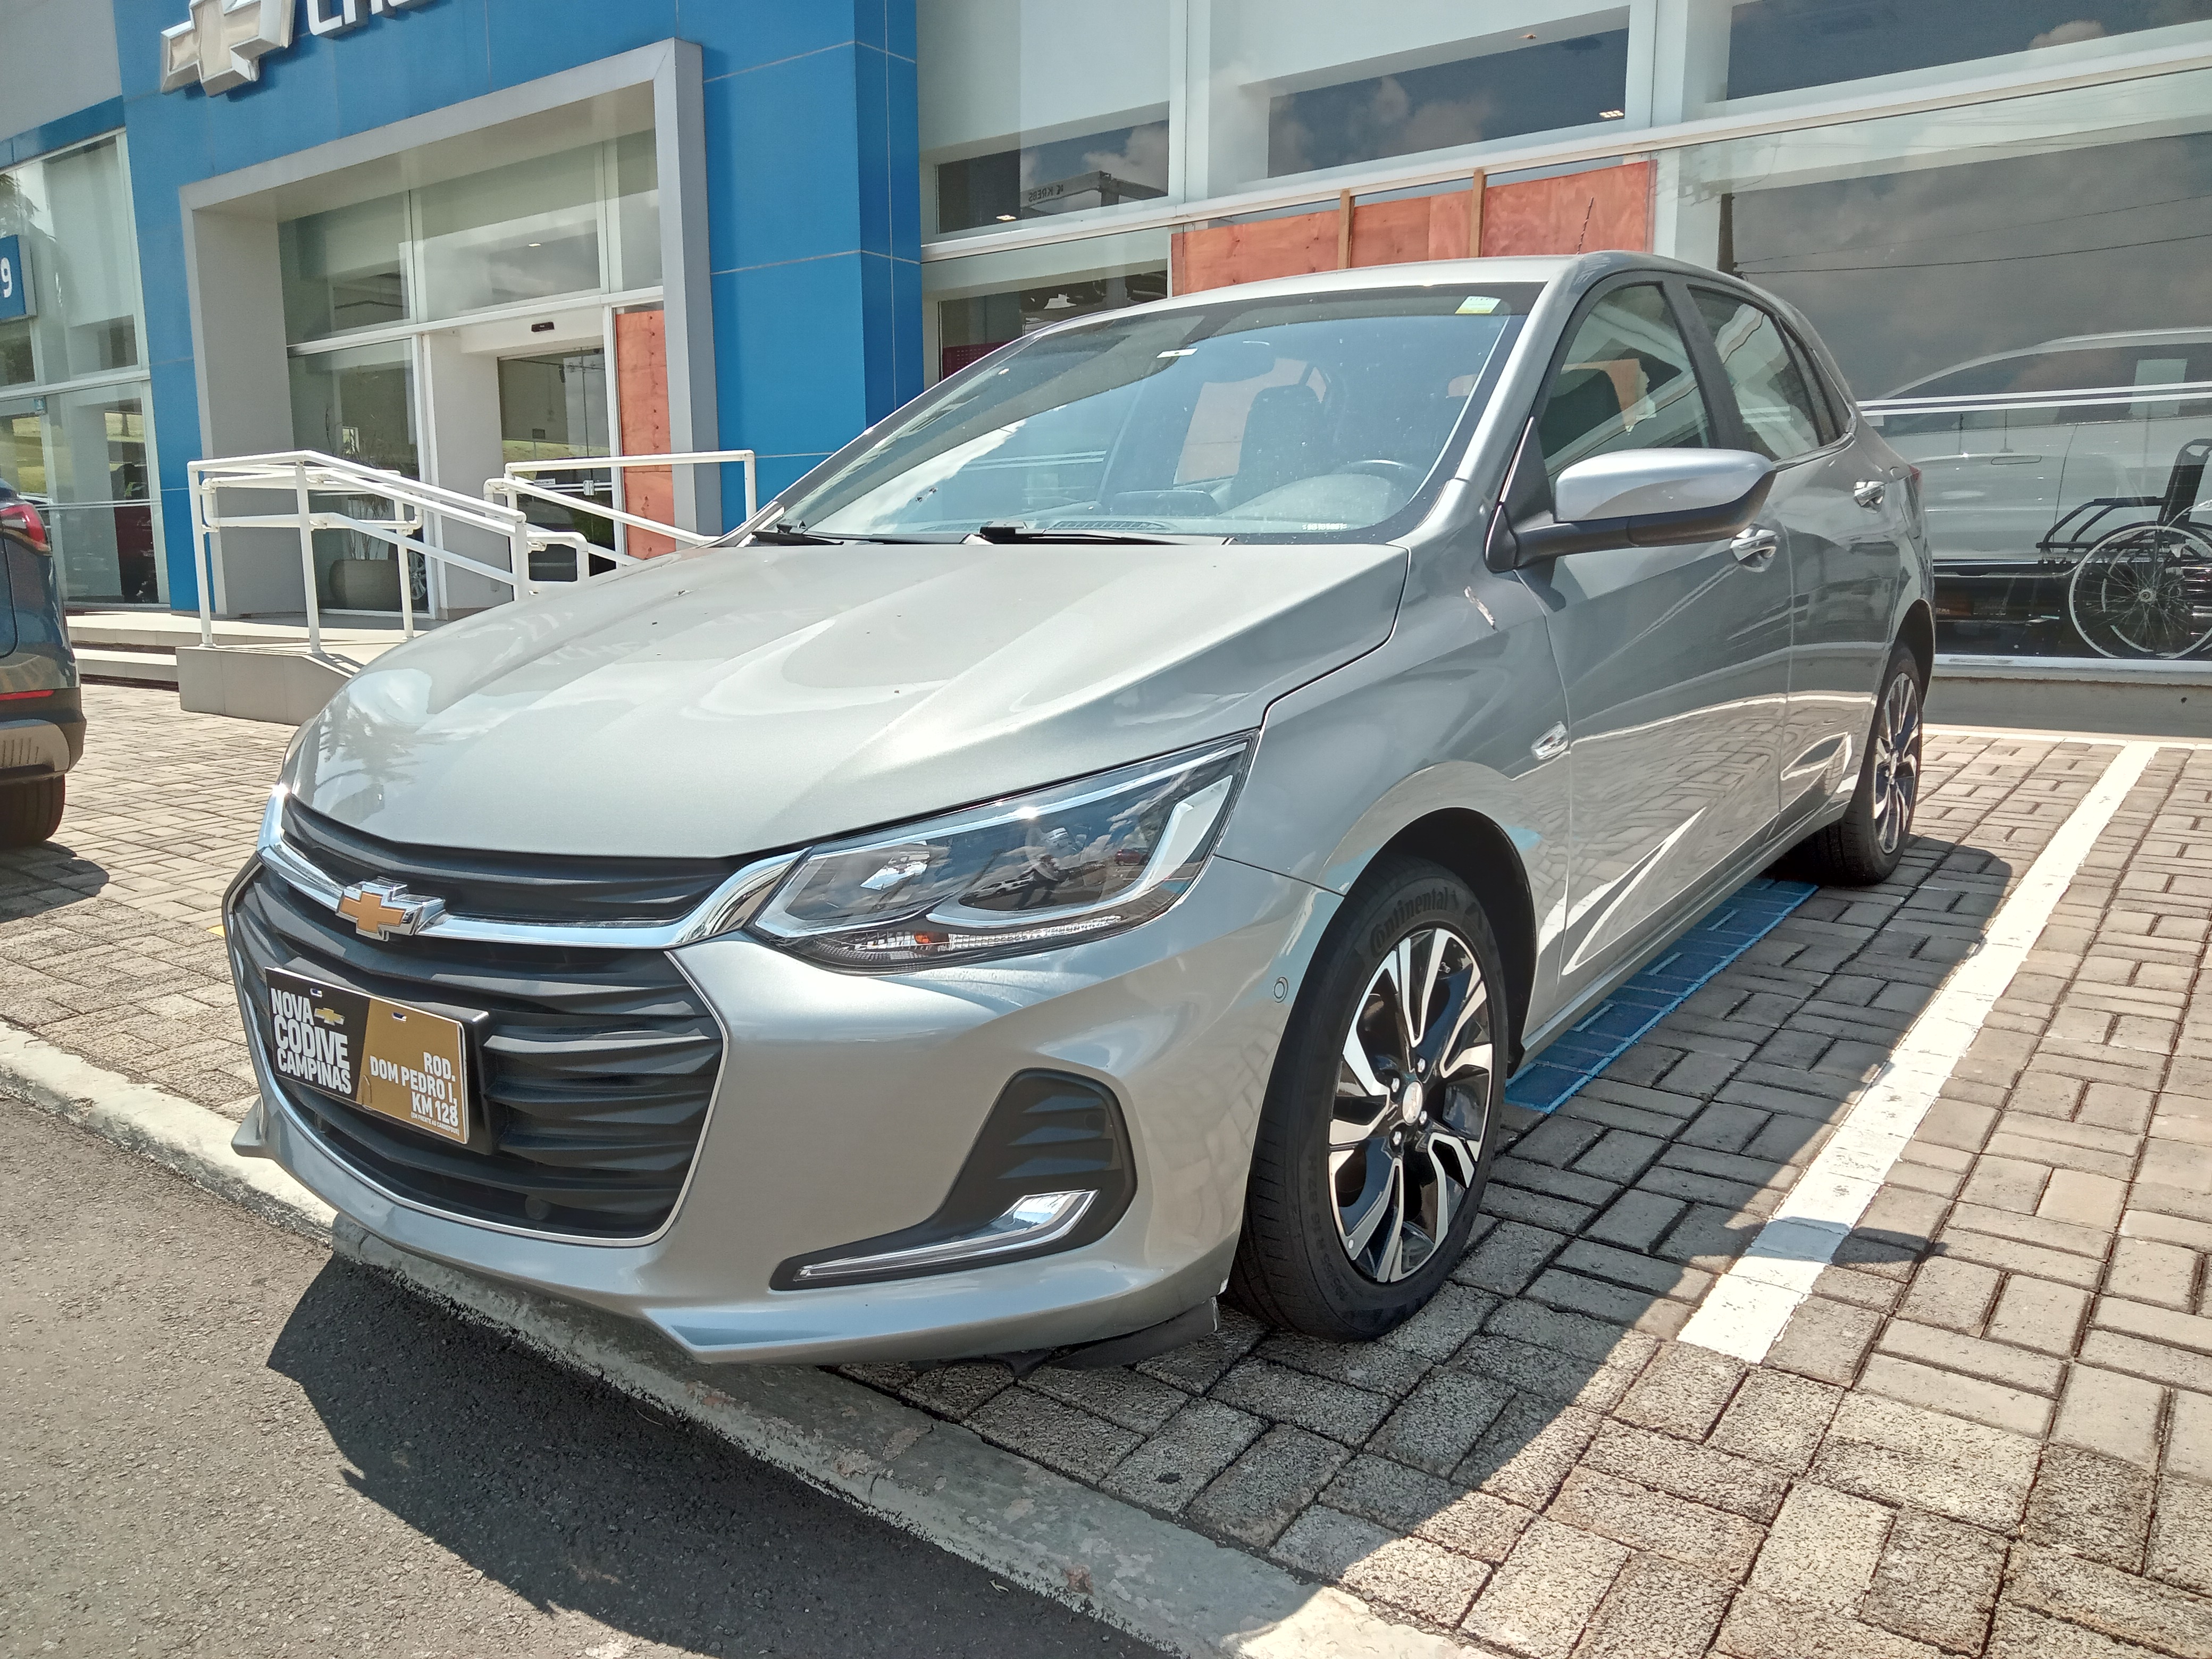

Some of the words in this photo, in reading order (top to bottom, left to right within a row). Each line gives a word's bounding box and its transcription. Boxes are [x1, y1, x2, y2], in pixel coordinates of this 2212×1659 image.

[1370, 887, 1448, 958] Continental
[271, 987, 314, 1026] NOVA
[274, 1015, 350, 1071] CODIVE
[277, 1048, 351, 1094] CAMPINAS
[370, 1055, 399, 1084] DOM
[401, 1066, 445, 1100] PEDRO
[448, 1082, 457, 1108] I,
[423, 1051, 456, 1082] ROD.
[412, 1091, 433, 1118] KM
[435, 1100, 458, 1127] 128
[418, 1114, 432, 1125] FRENTE
